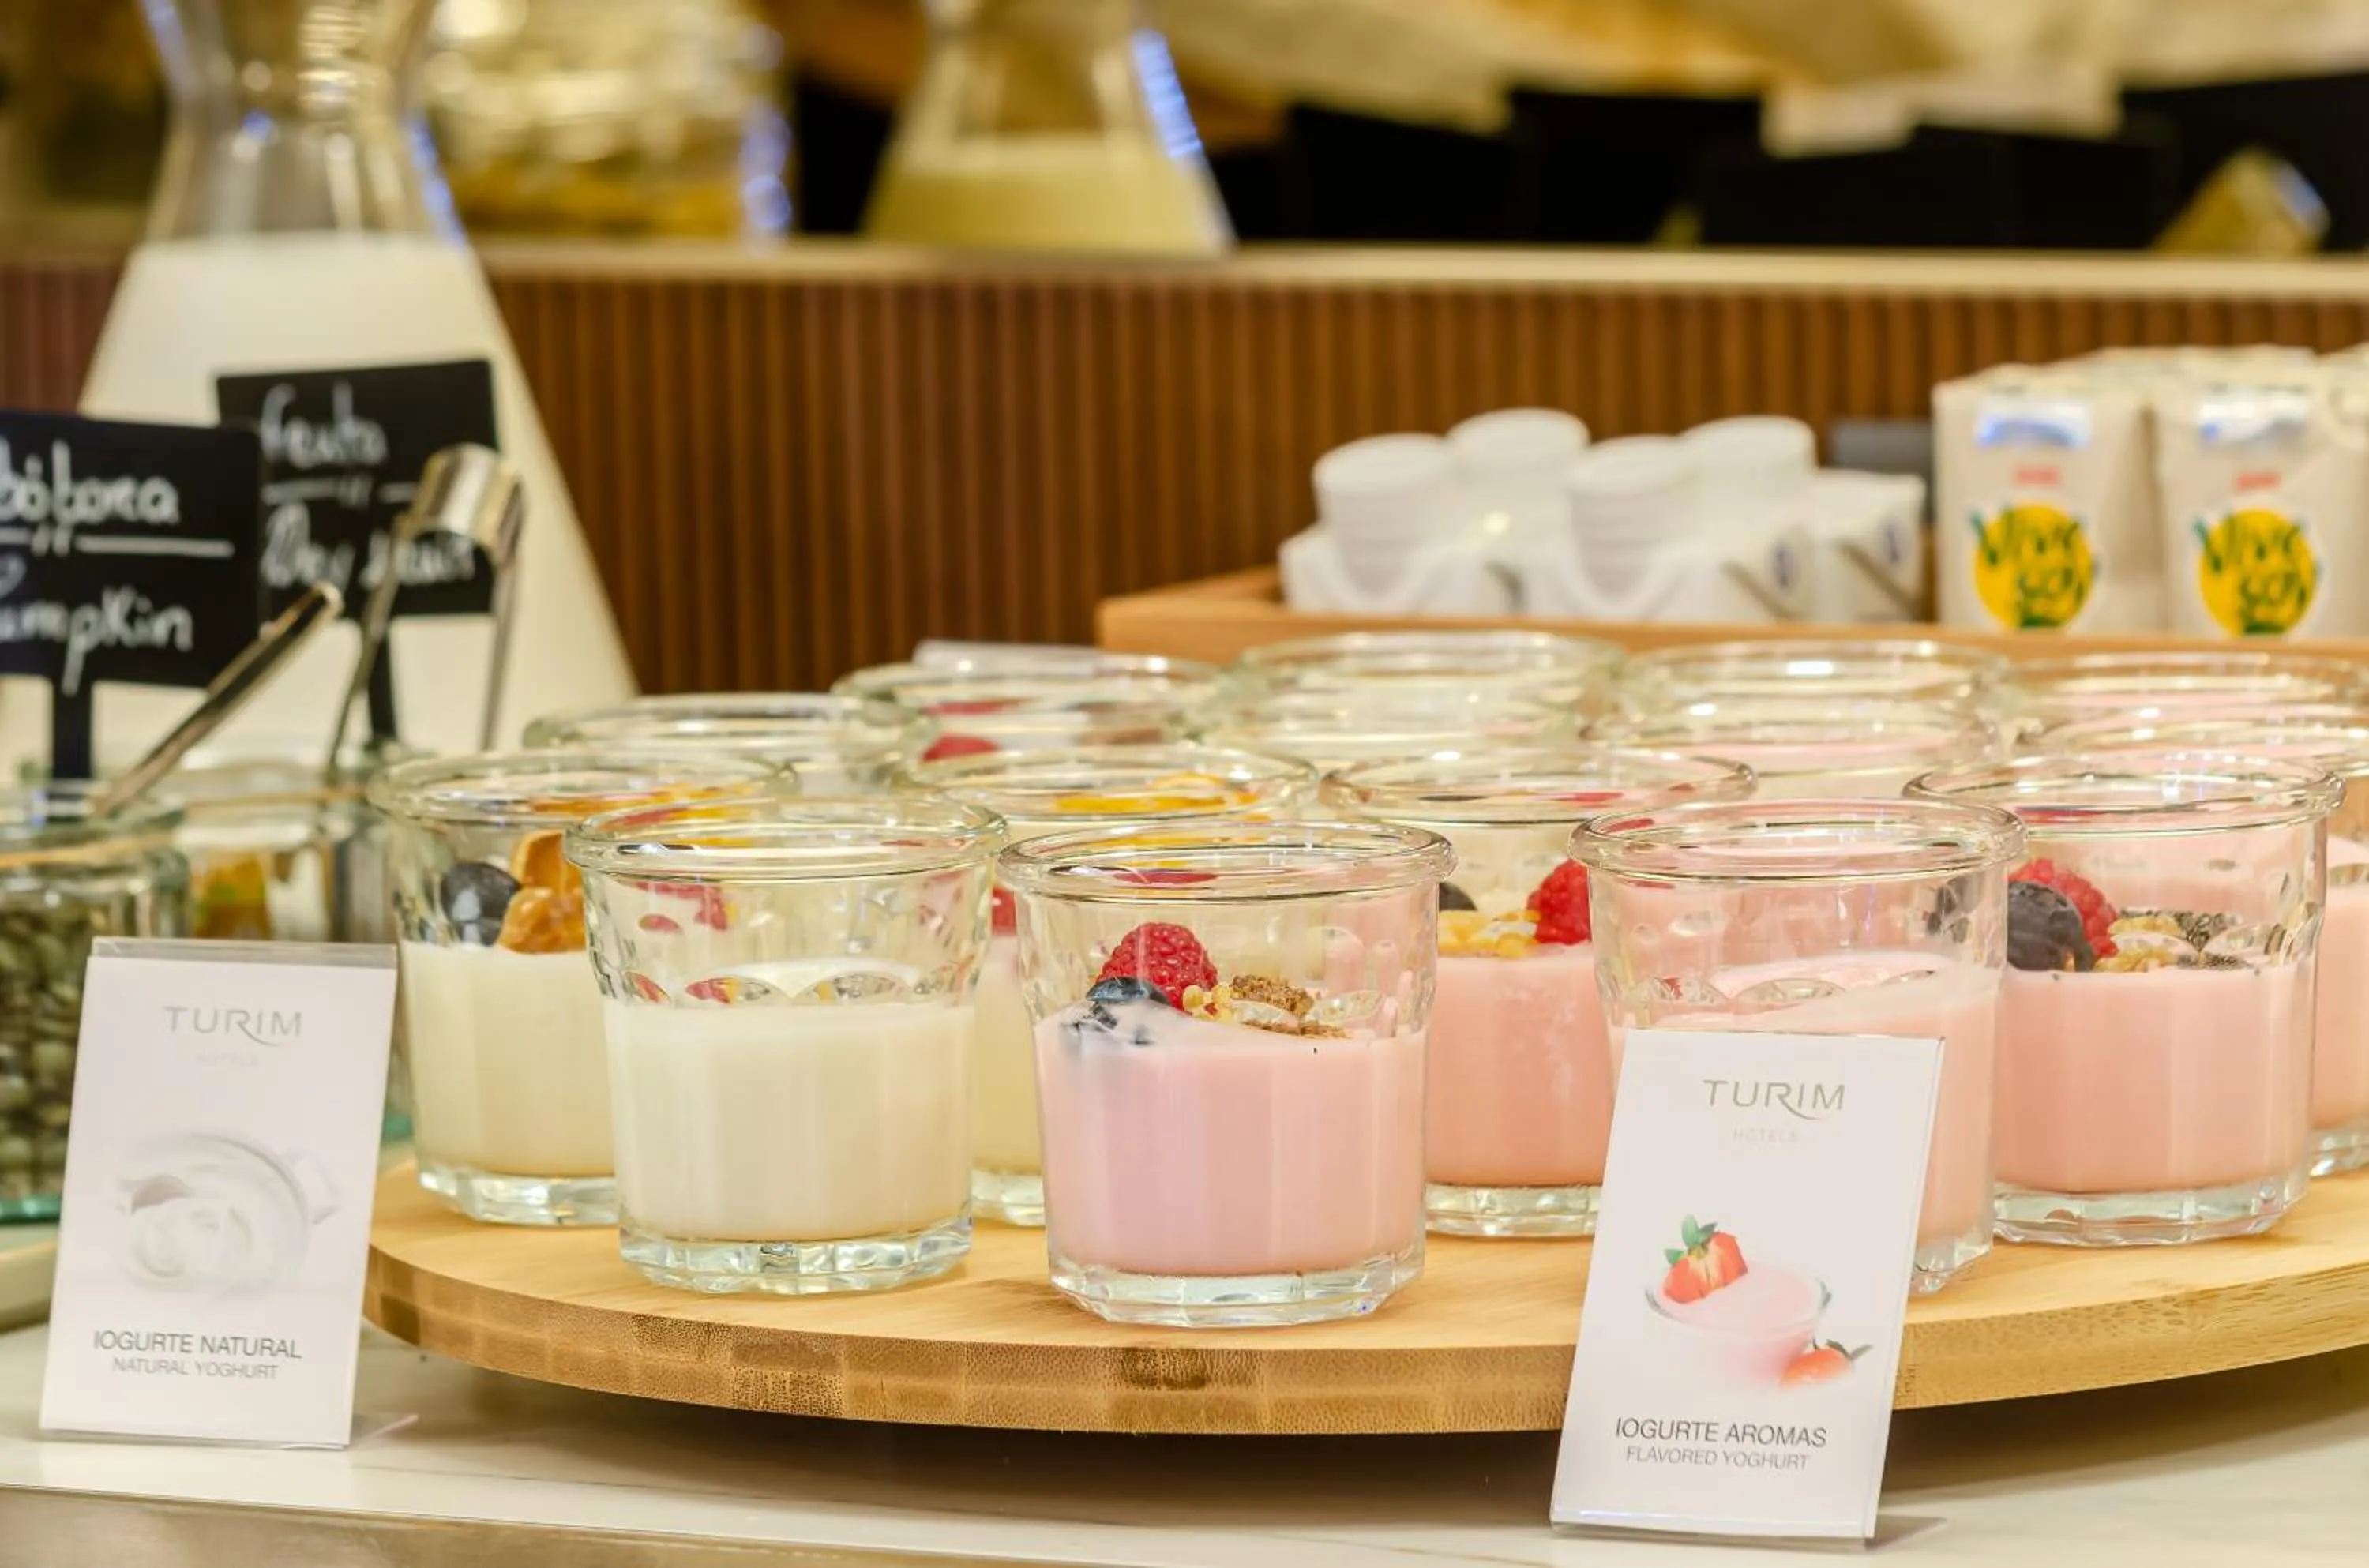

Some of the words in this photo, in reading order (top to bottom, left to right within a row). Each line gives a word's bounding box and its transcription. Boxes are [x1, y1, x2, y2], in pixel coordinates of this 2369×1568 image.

[163, 1005, 302, 1047] TURIM
[1702, 1078, 1846, 1120] TURIM
[1732, 1127, 1800, 1144] HOTELS
[94, 1330, 193, 1354] IOGURTE
[200, 1334, 303, 1360] NATURAL
[112, 1356, 190, 1376] NATURAL
[197, 1360, 280, 1379] YOGHURT
[1615, 1417, 1720, 1442] IOGURTE
[1725, 1424, 1828, 1448] AROMAS
[1626, 1445, 1718, 1467] FLAVORED
[1722, 1450, 1810, 1471] YOGHURT
